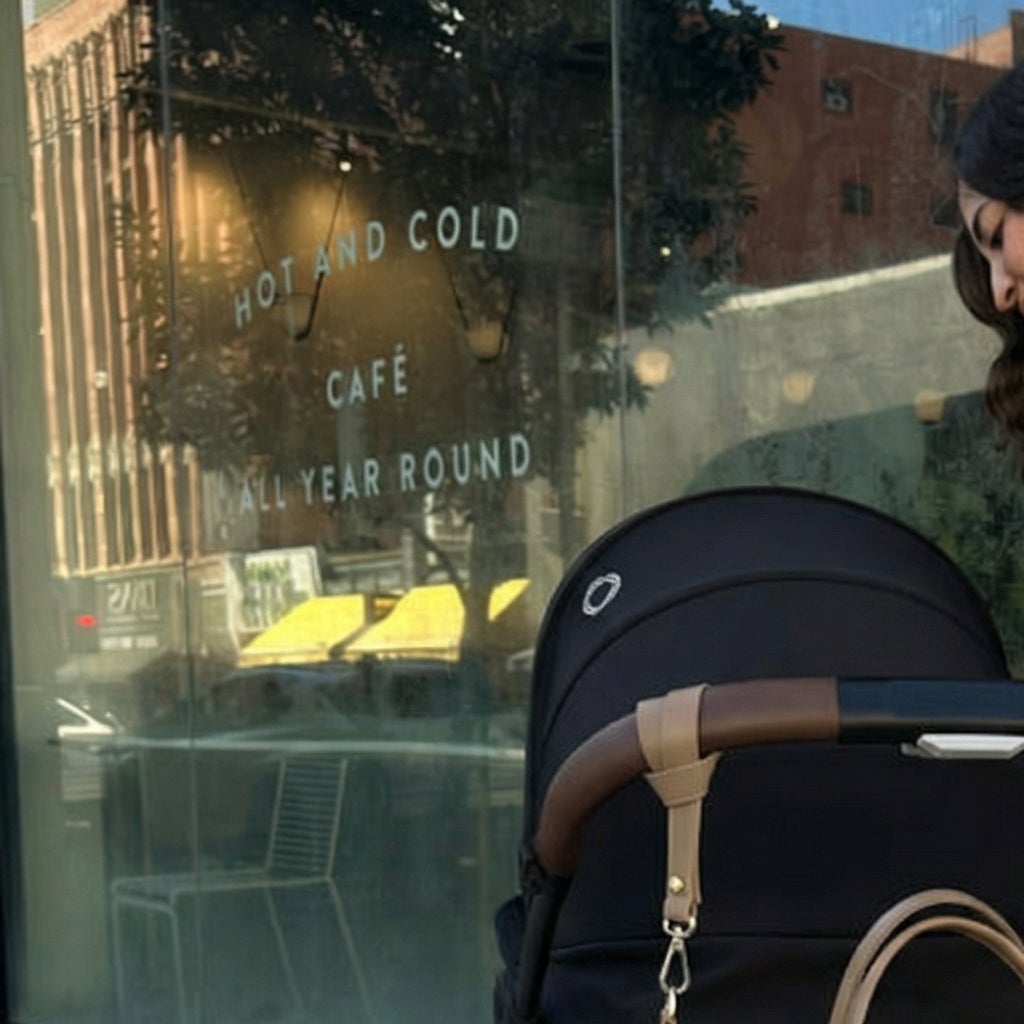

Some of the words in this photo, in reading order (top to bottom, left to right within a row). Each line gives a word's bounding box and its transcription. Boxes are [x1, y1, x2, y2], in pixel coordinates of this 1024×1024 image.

[234, 256, 294, 329] HOT
[313, 220, 386, 282] AND
[408, 205, 520, 251] COLD
[325, 343, 409, 409] CAFÉ
[239, 473, 287, 516] ALL
[300, 458, 380, 505] YEAR
[400, 433, 530, 488] ROUND
